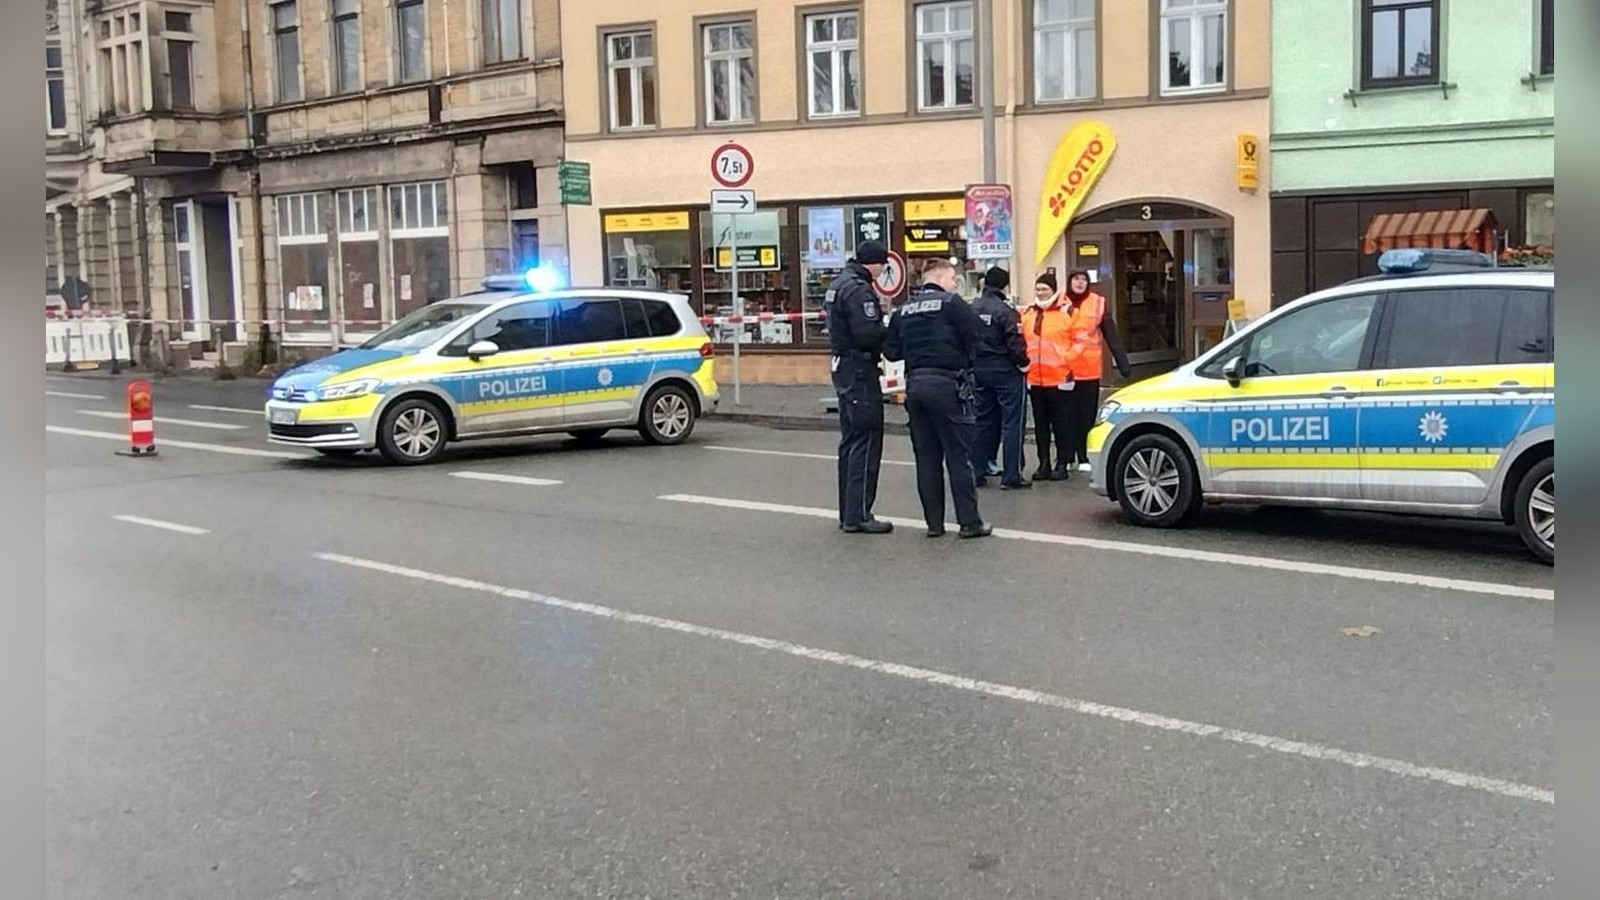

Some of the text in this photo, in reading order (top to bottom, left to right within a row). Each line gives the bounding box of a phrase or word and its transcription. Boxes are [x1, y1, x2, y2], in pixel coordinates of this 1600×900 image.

[721, 156, 743, 175] 7,5t
[1060, 139, 1104, 197] LOTTO
[1140, 205, 1153, 221] 3
[900, 299, 943, 317] POLIZEI
[478, 375, 548, 399] POLIZEI
[1230, 415, 1330, 443] POLIZEI
